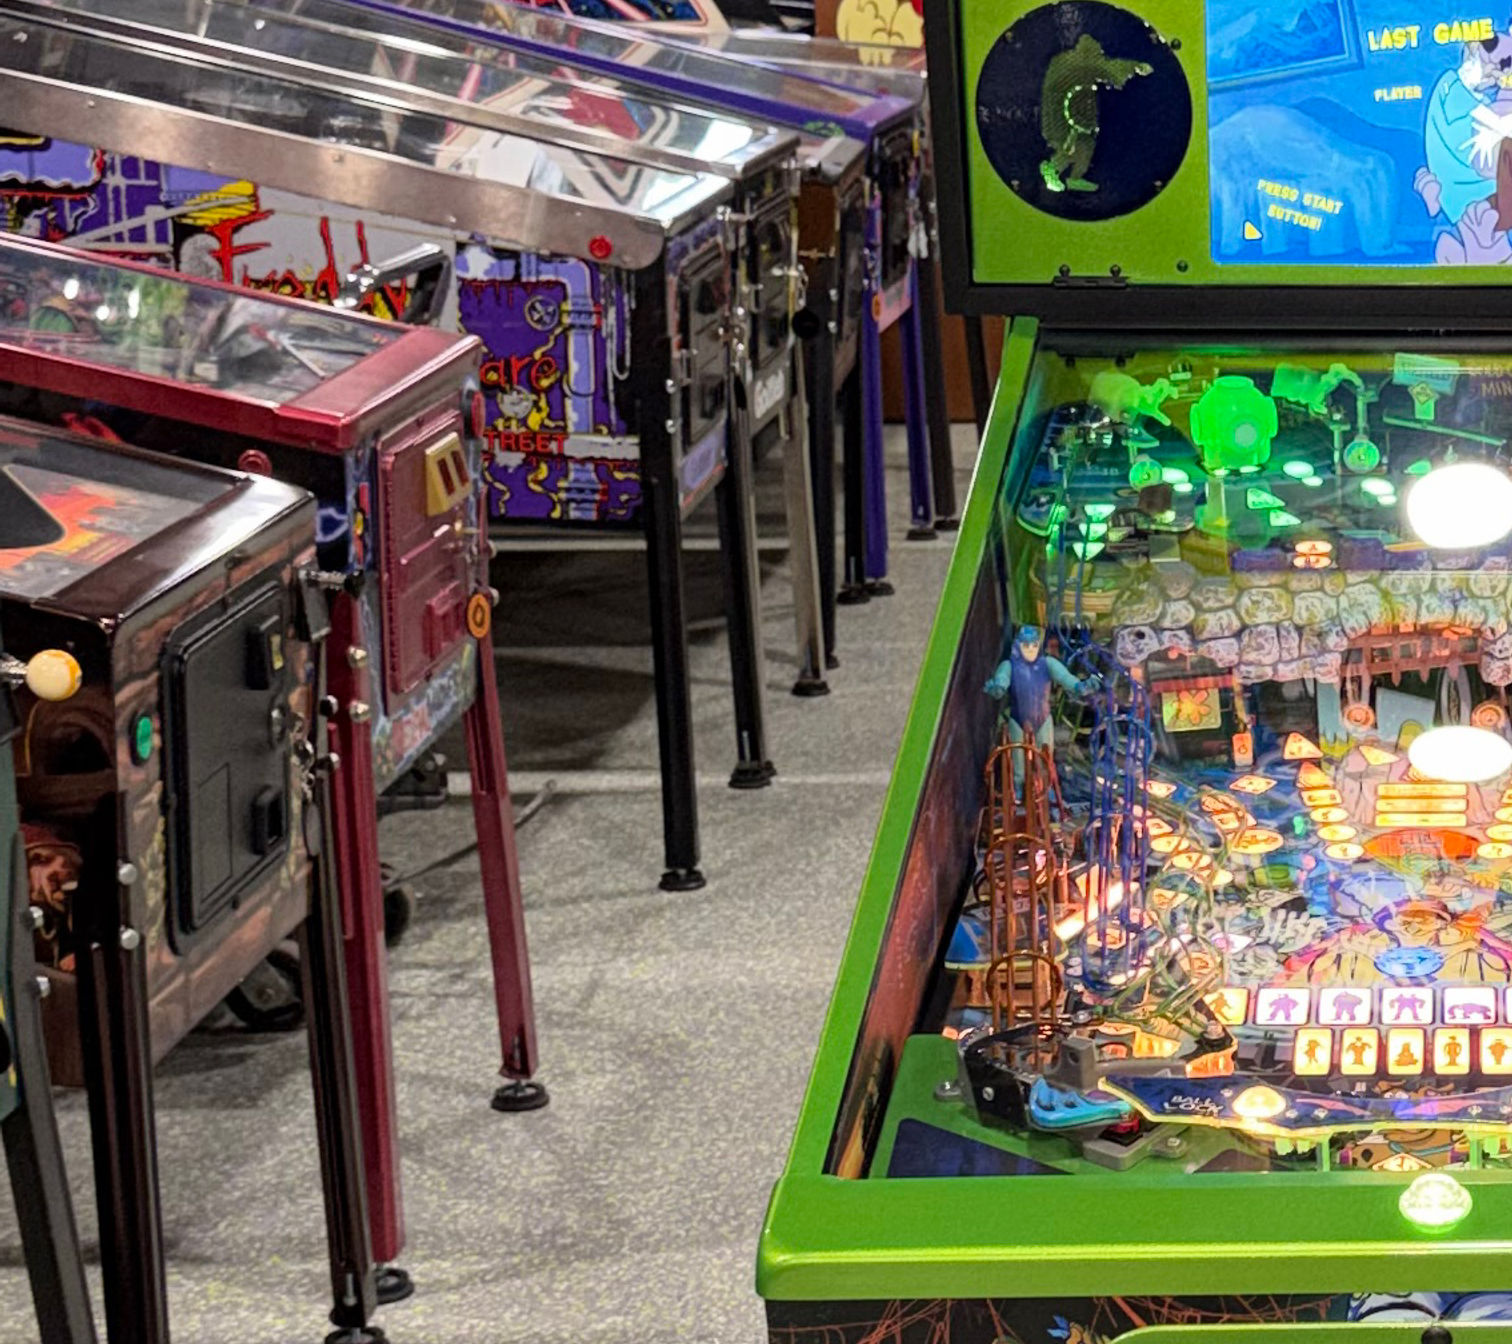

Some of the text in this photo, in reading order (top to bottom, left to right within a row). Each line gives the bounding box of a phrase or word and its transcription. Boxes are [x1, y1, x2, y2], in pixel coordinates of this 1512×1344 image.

[1367, 17, 1496, 52] LAST GAME
[1373, 86, 1423, 103] PLAYER
[1302, 192, 1344, 215] START
